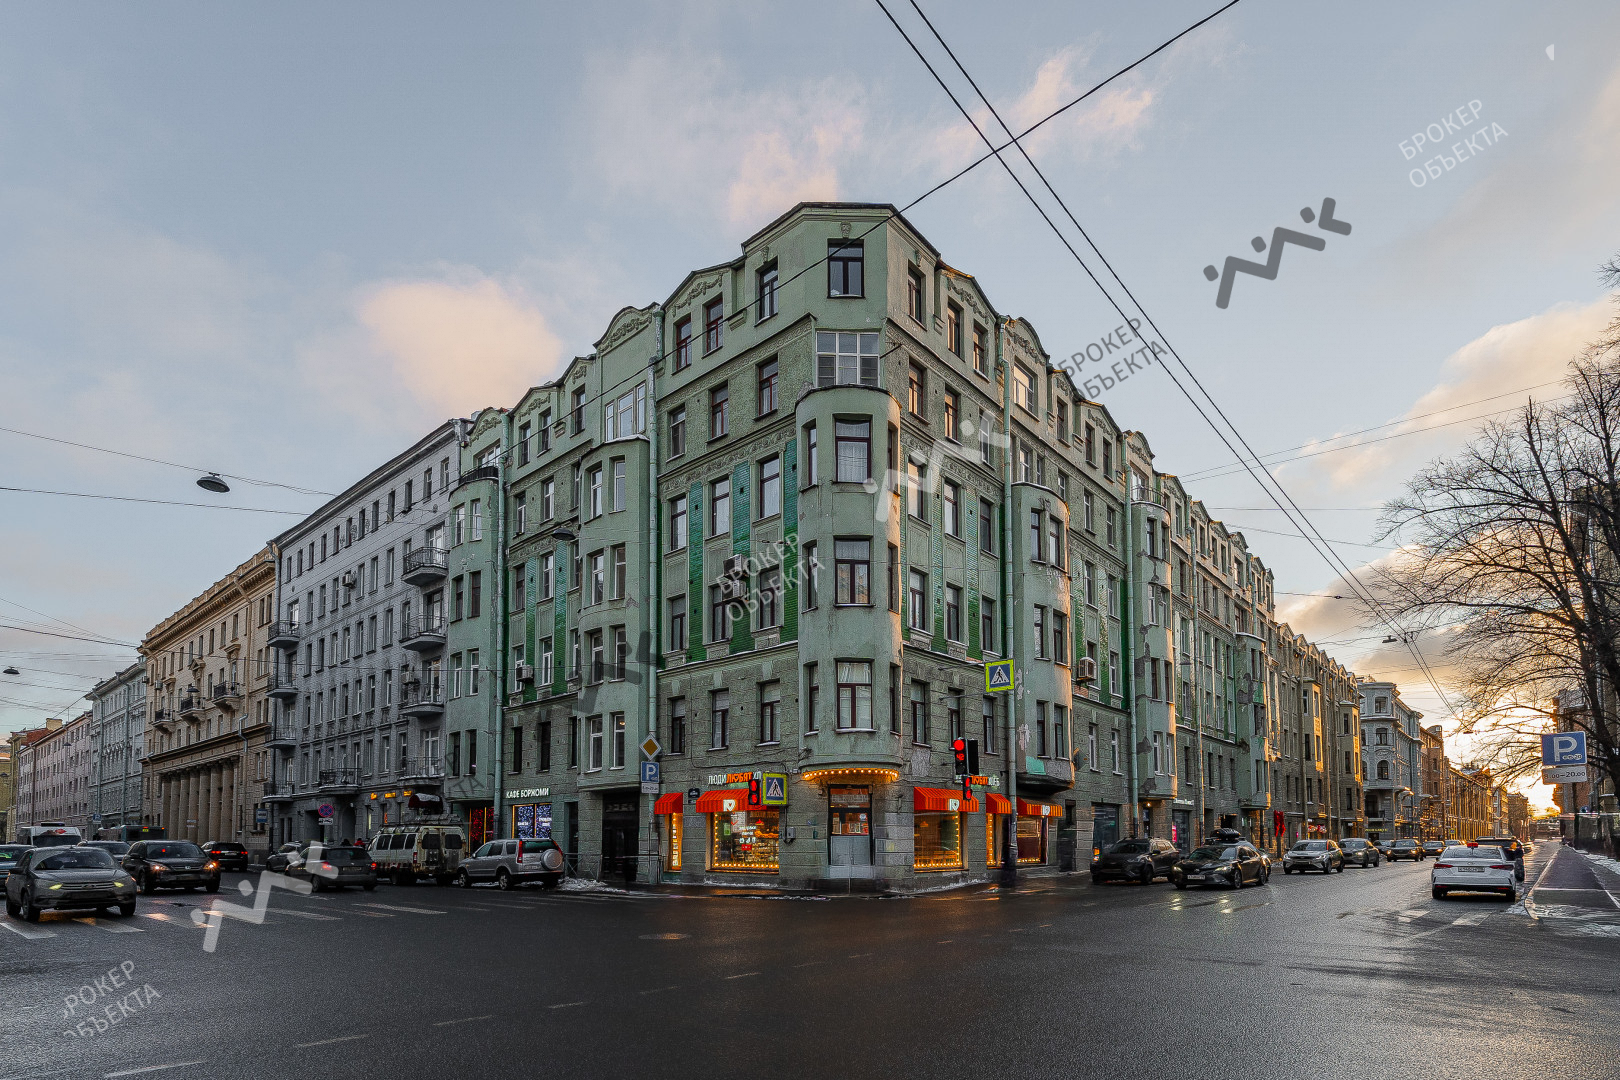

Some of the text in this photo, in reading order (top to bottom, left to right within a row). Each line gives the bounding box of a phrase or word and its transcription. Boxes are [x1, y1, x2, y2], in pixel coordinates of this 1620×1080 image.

[1553, 736, 1577, 761] P
[645, 764, 656, 780] P
[506, 788, 549, 798] КАФЕ БОРЖОМИ
